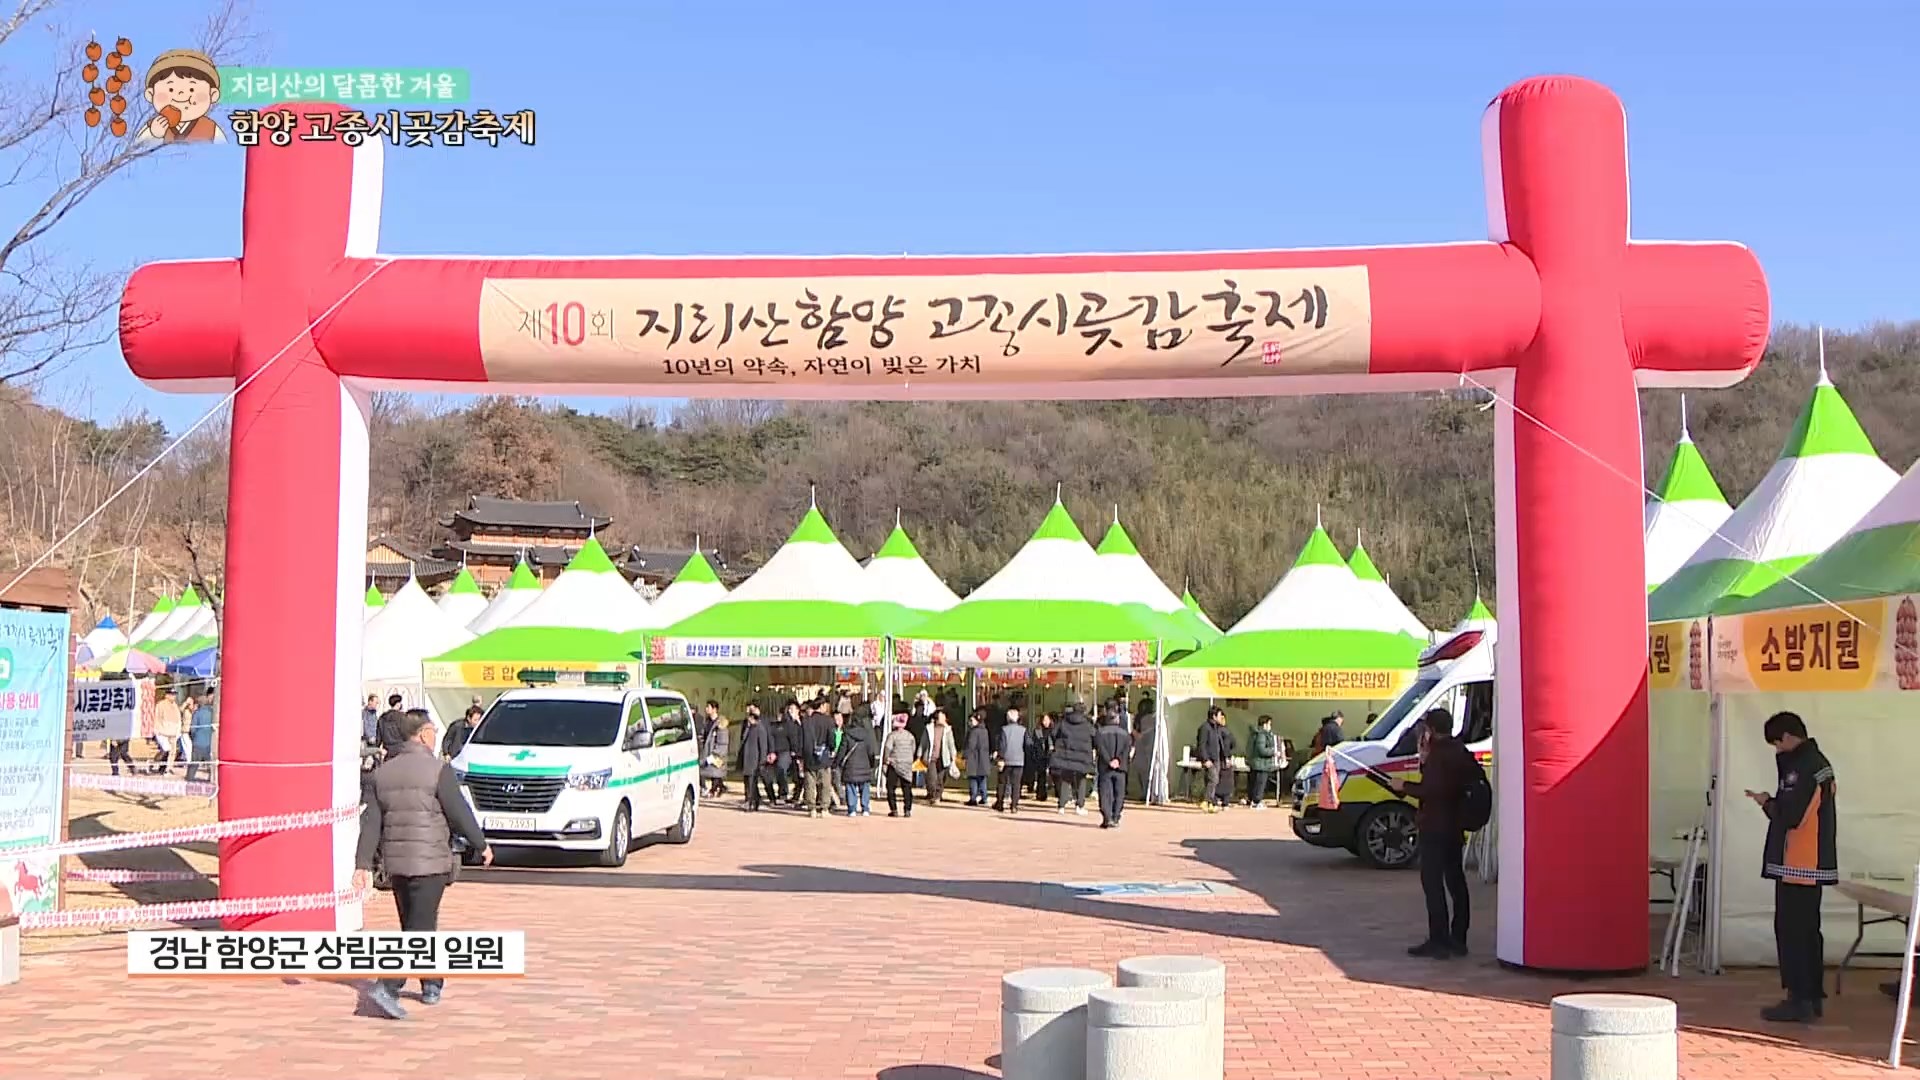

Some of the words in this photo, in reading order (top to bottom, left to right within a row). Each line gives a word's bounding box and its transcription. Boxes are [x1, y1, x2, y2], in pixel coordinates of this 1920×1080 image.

[517, 300, 615, 347] 제10회
[635, 287, 907, 350] 지리산함양
[662, 357, 734, 377] 10년의
[743, 357, 796, 377] 약속,
[804, 356, 872, 376] 자연이
[881, 355, 928, 375] 빚은
[936, 354, 981, 374] 가치
[1761, 620, 1860, 673] 소방지원
[1217, 671, 1308, 689] 한국여성농업인
[1311, 671, 1391, 690] 함양군연합회
